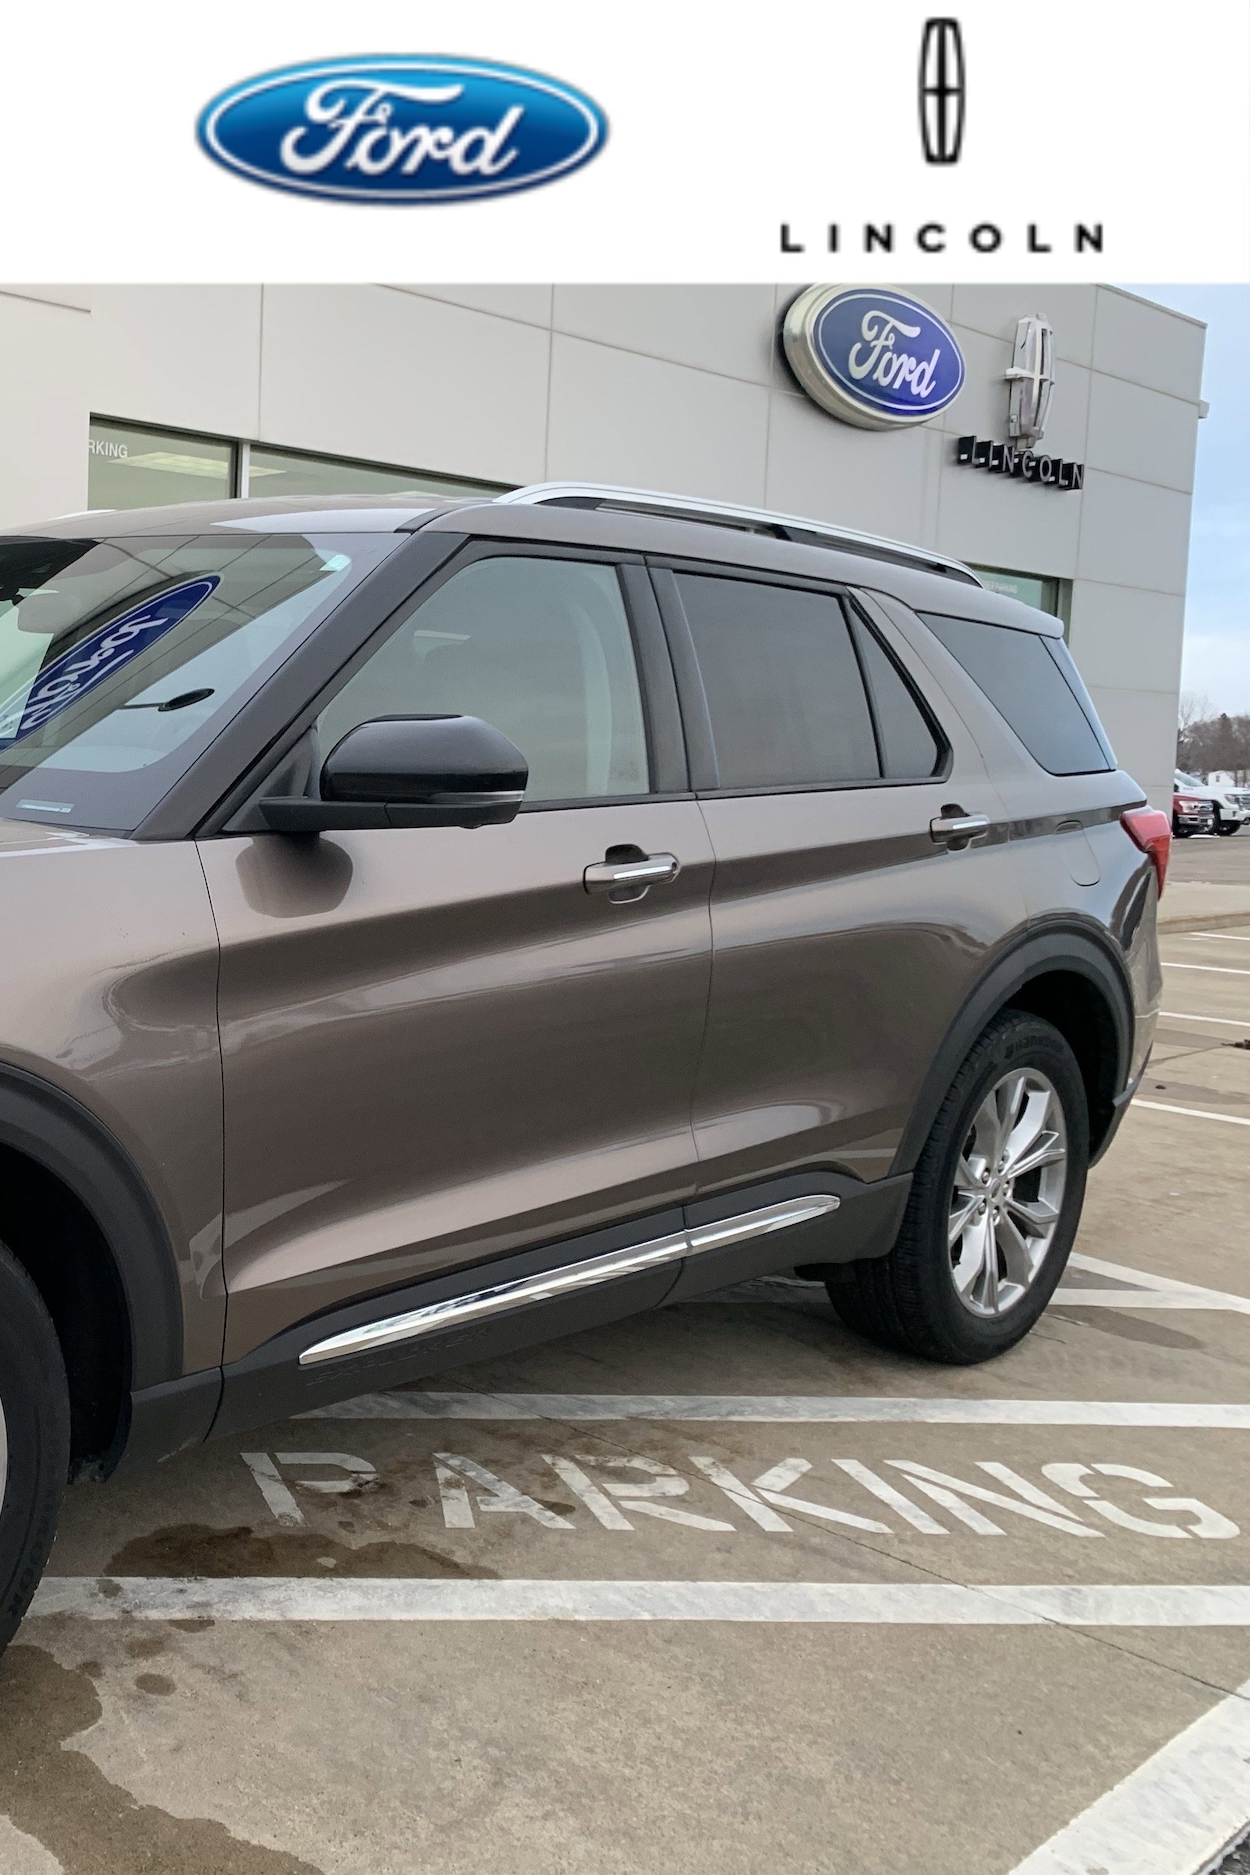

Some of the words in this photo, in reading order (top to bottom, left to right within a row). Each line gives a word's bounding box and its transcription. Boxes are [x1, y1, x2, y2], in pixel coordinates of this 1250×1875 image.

[848, 310, 941, 399] Ford
[959, 435, 1085, 490] LINCOLN
[239, 1450, 1241, 1540] PARKING
